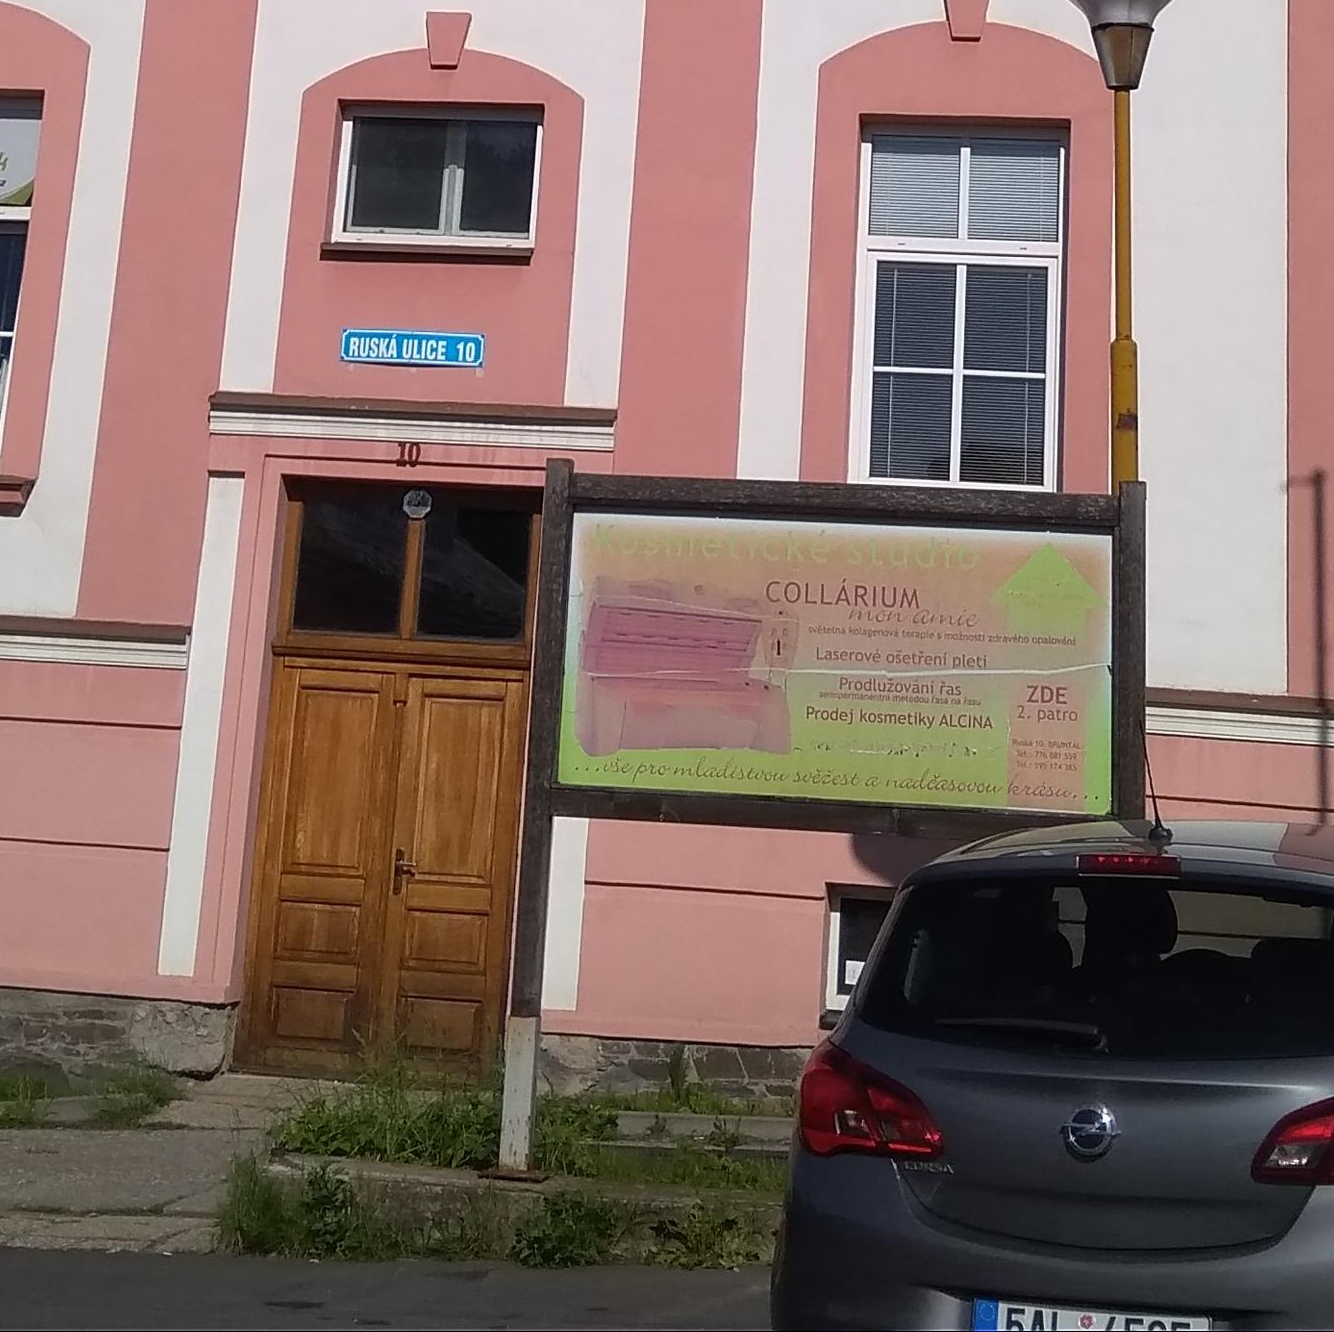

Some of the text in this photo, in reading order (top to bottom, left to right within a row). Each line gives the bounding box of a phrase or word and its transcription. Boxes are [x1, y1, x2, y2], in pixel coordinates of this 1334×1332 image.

[349, 334, 476, 362] RUSKÁ ULICE 10
[396, 442, 421, 468] 10
[593, 523, 828, 564] Kosmetické
[766, 578, 920, 609] COLLÁRIUM
[902, 629, 934, 640] terapie
[937, 631, 942, 640] s
[988, 634, 1028, 644] zdravého
[1032, 636, 1076, 646] opalování
[817, 647, 987, 669] Laserové ošetření pleti
[839, 677, 961, 696] Prodlužování řas
[1027, 685, 1067, 704] ZDE
[892, 695, 928, 704] metodou
[806, 706, 993, 730] Prodej kosmetiky ALCINA
[1017, 705, 1078, 722] 2. patro
[632, 763, 670, 783] pro
[674, 757, 790, 783] mladistvou
[865, 775, 881, 787] a
[886, 769, 1002, 794] nadčasovou
